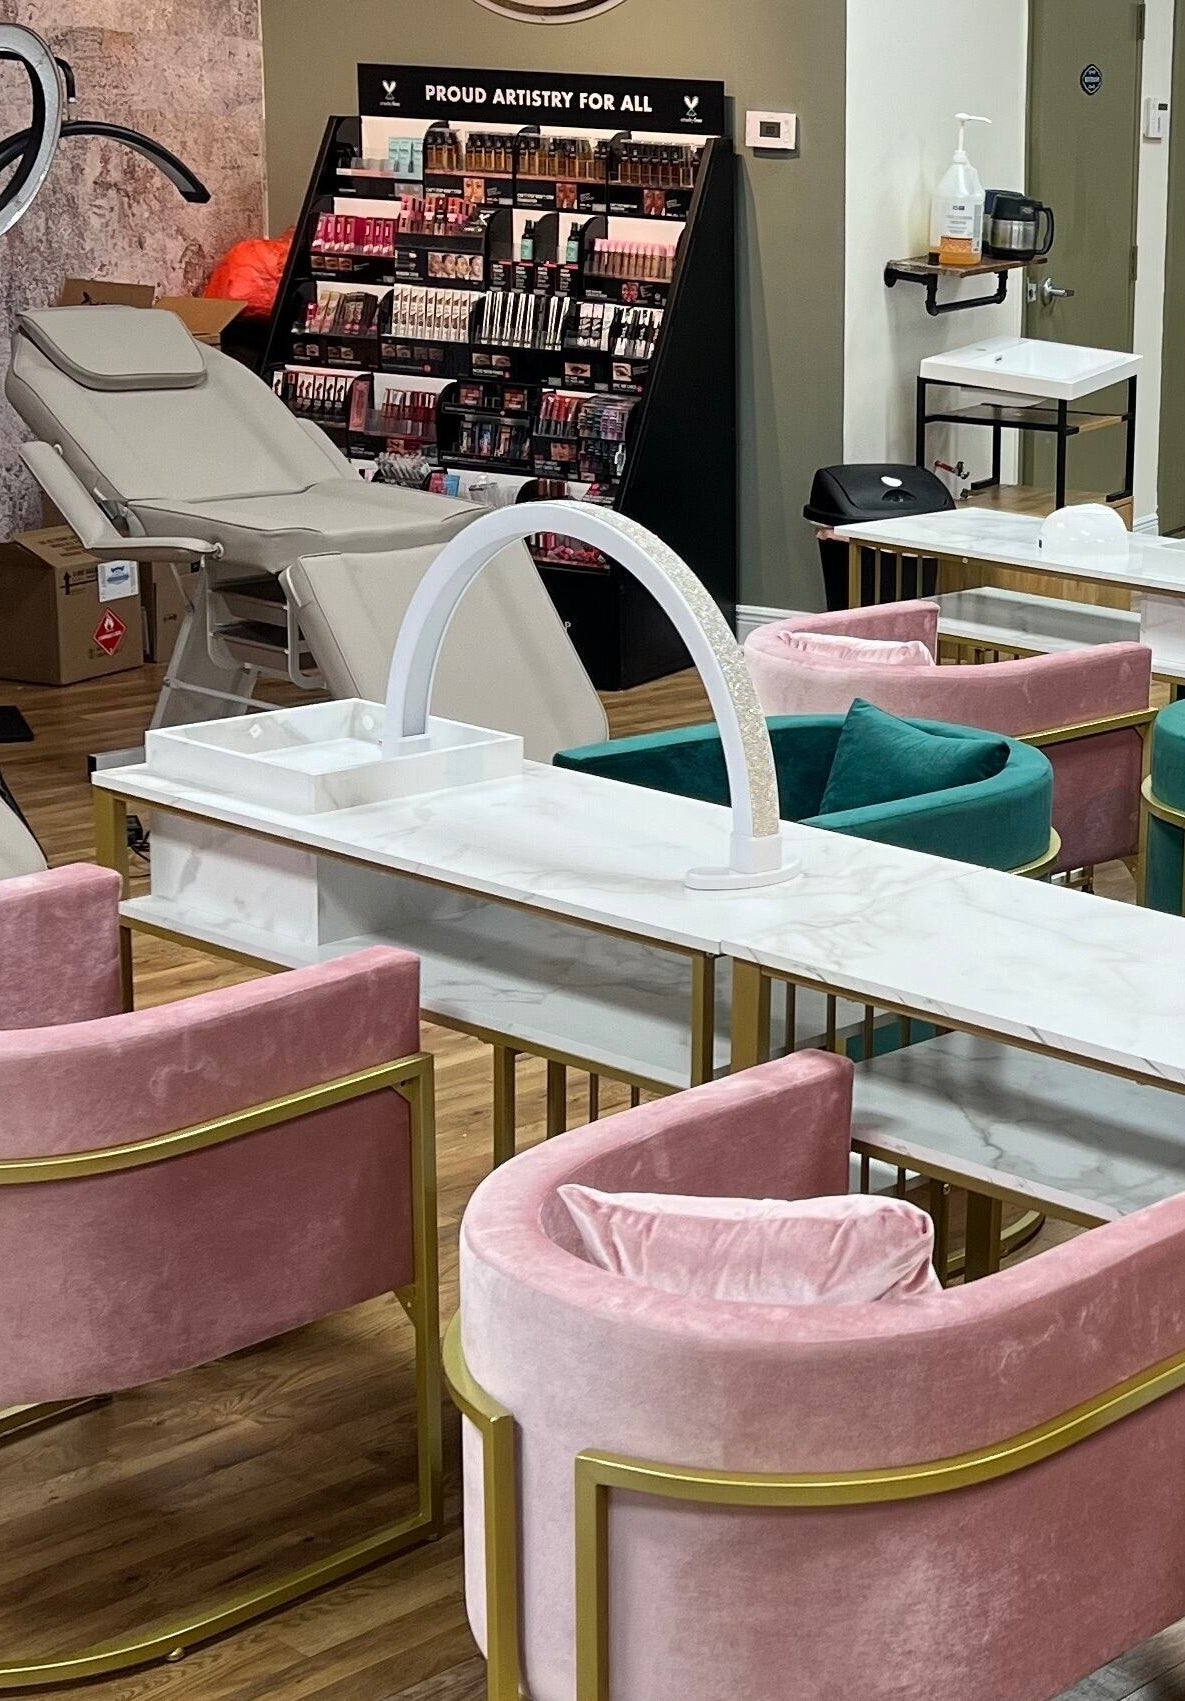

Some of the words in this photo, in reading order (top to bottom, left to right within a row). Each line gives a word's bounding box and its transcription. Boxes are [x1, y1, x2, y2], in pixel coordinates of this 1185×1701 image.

[425, 84, 487, 103] PROUD
[492, 88, 574, 108] ARTISTRY
[579, 92, 616, 111] FOR
[620, 95, 653, 113] ALL
